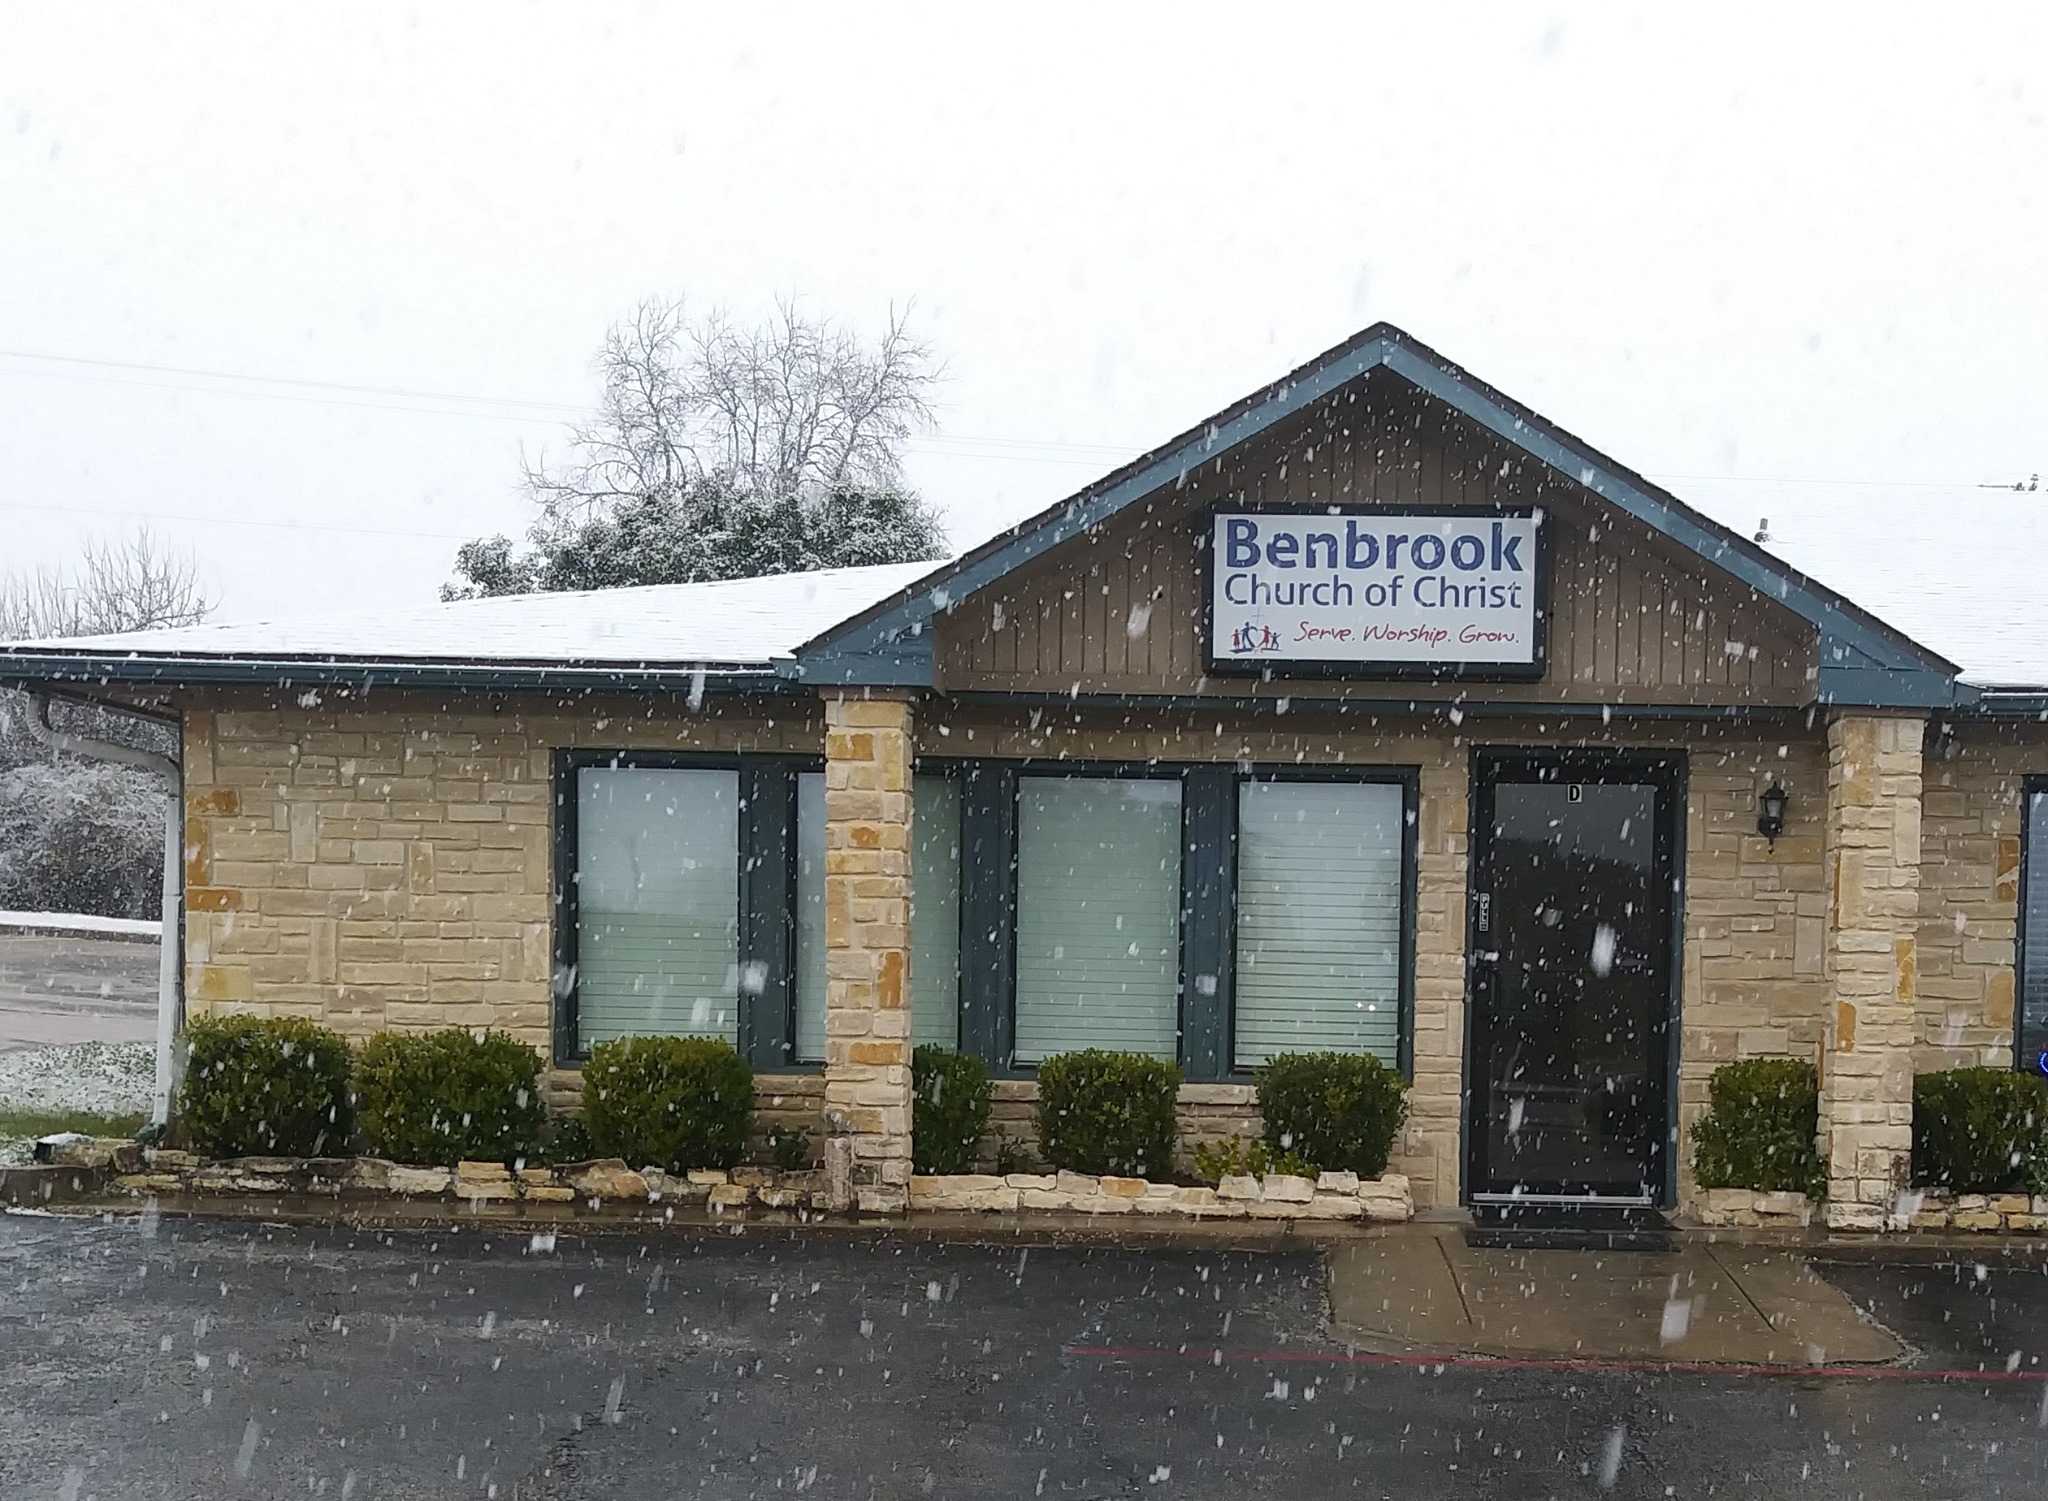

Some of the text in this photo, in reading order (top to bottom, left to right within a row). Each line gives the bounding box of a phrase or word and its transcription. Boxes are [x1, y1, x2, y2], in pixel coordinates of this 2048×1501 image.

[1226, 518, 1524, 572] Benbrook
[1224, 573, 1522, 609] Church of Christ
[1293, 621, 1520, 648] Serve. Worship. Grow.
[1569, 785, 1580, 801] D
